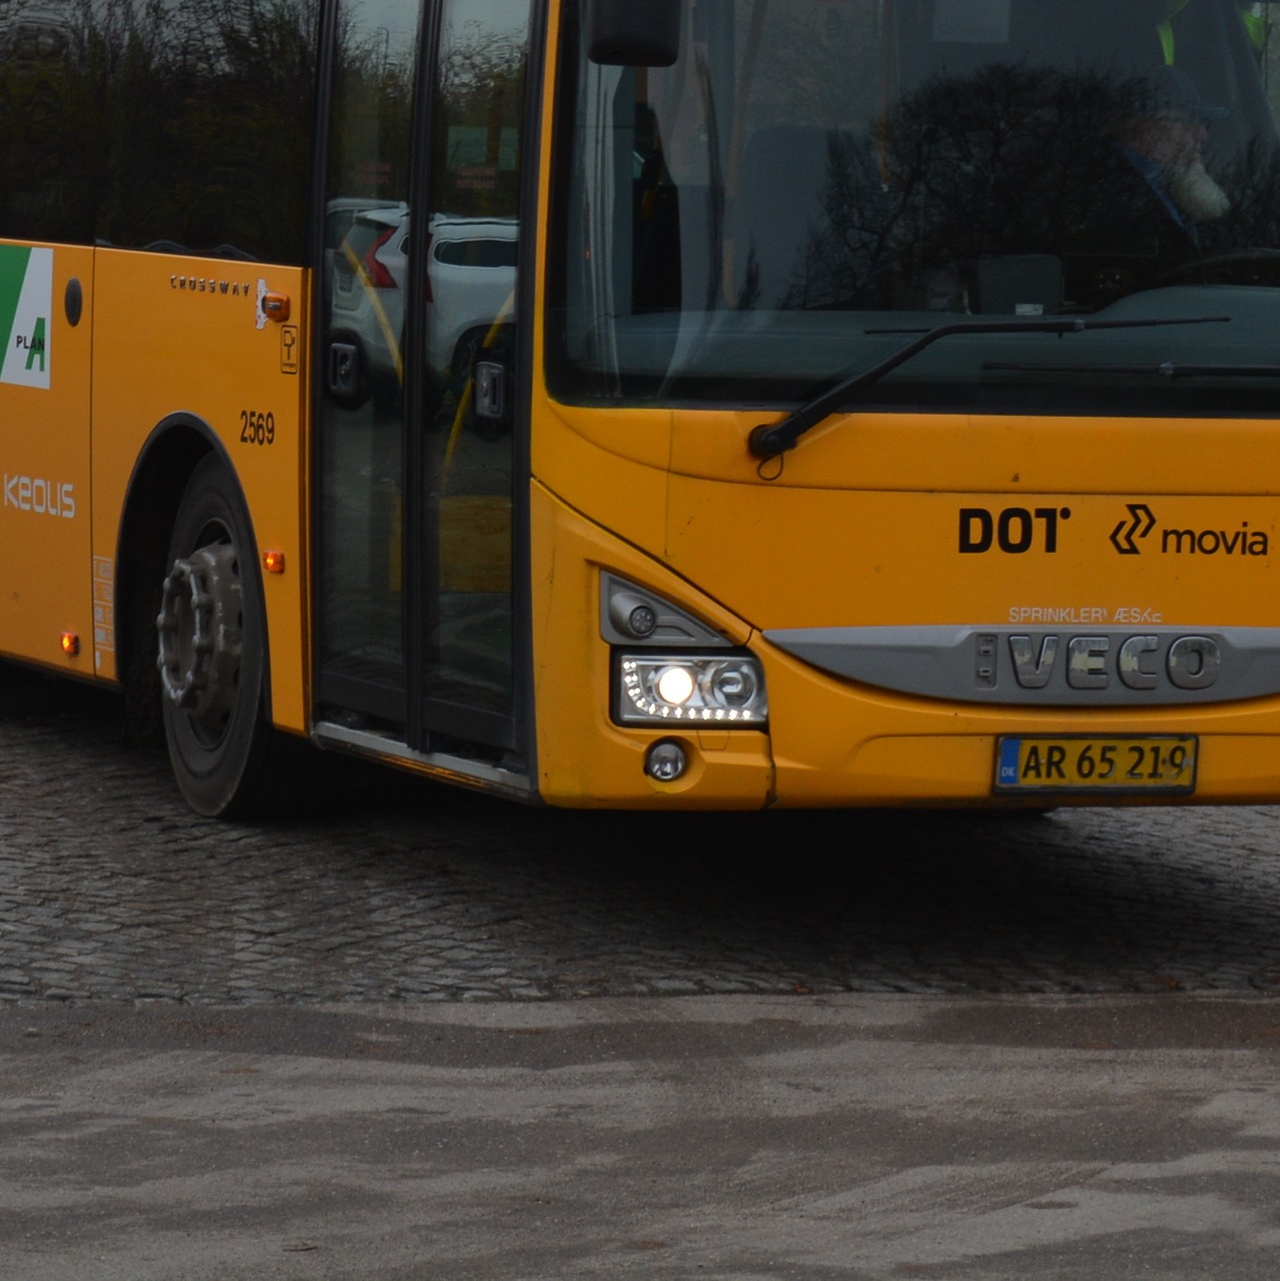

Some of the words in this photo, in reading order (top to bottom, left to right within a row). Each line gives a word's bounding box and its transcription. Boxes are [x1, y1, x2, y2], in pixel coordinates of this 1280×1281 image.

[170, 274, 250, 297] CROSSWAY
[16, 335, 45, 351] PLAN
[25, 317, 46, 372] A
[240, 409, 275, 446] 2569
[958, 507, 1070, 554] DOT
[1161, 521, 1269, 556] movia
[1001, 767, 1015, 777] DK
[1021, 745, 1066, 779] AR
[1076, 744, 1117, 779] 65
[1126, 745, 1188, 779] 219
